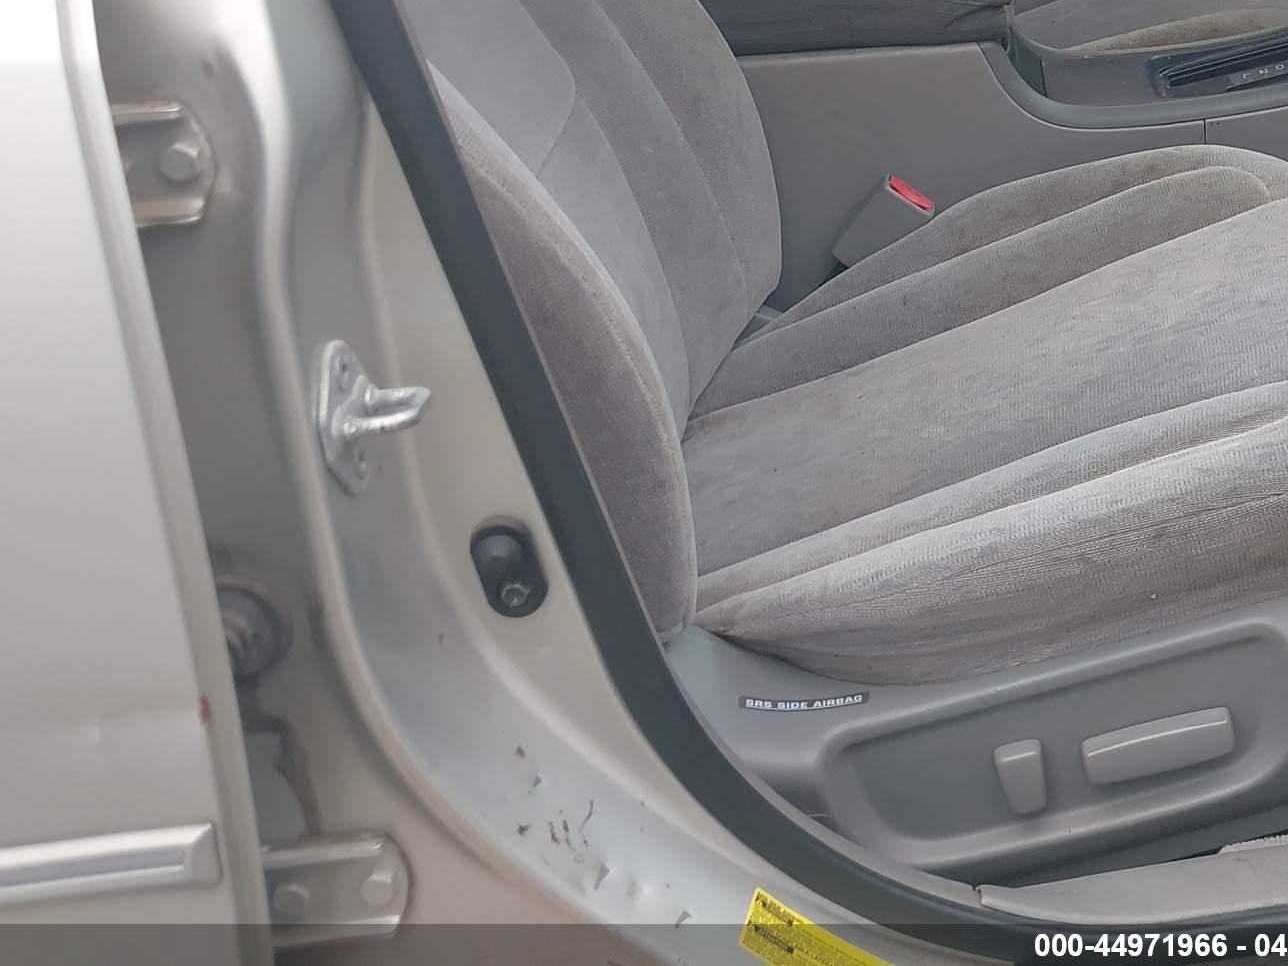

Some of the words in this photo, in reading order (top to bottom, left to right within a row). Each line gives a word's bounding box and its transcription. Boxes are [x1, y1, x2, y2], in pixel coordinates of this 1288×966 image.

[745, 698, 773, 709] SRS
[777, 700, 809, 710] SIDE
[813, 694, 863, 708] AIRBAG
